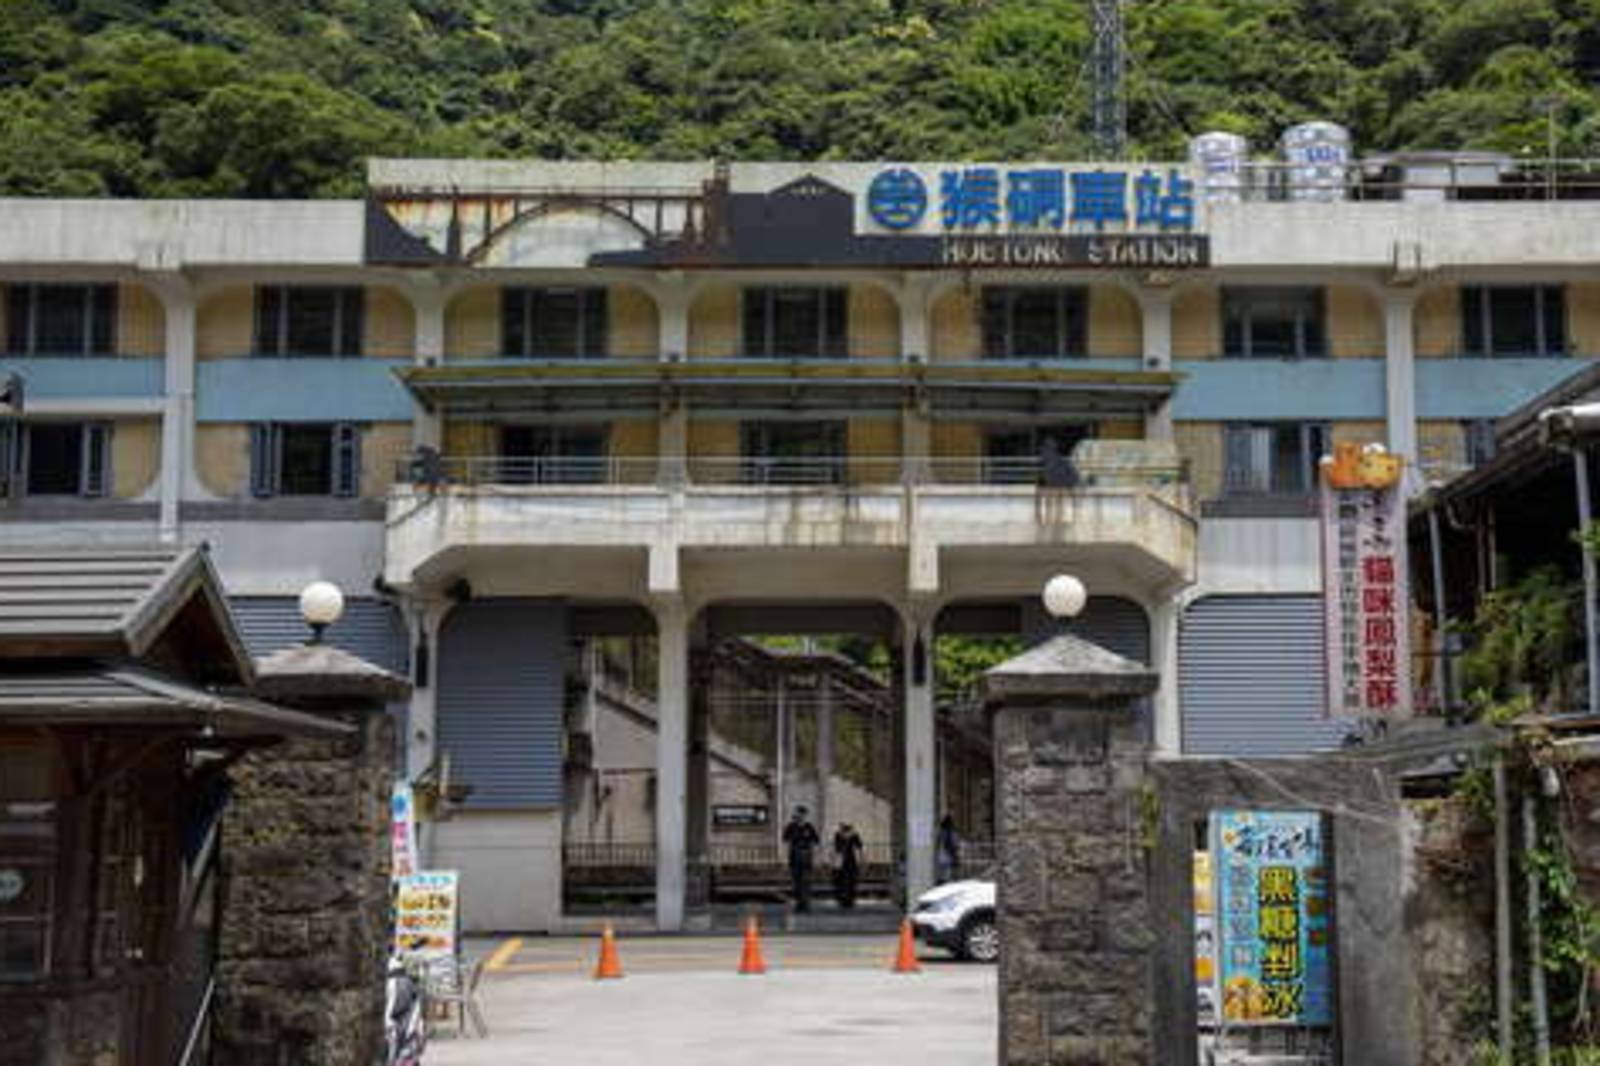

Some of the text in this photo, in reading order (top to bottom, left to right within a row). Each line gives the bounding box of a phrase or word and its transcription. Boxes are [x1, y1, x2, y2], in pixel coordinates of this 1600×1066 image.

[939, 167, 1194, 231] 猴硐車站
[1087, 236, 1199, 264] STATION
